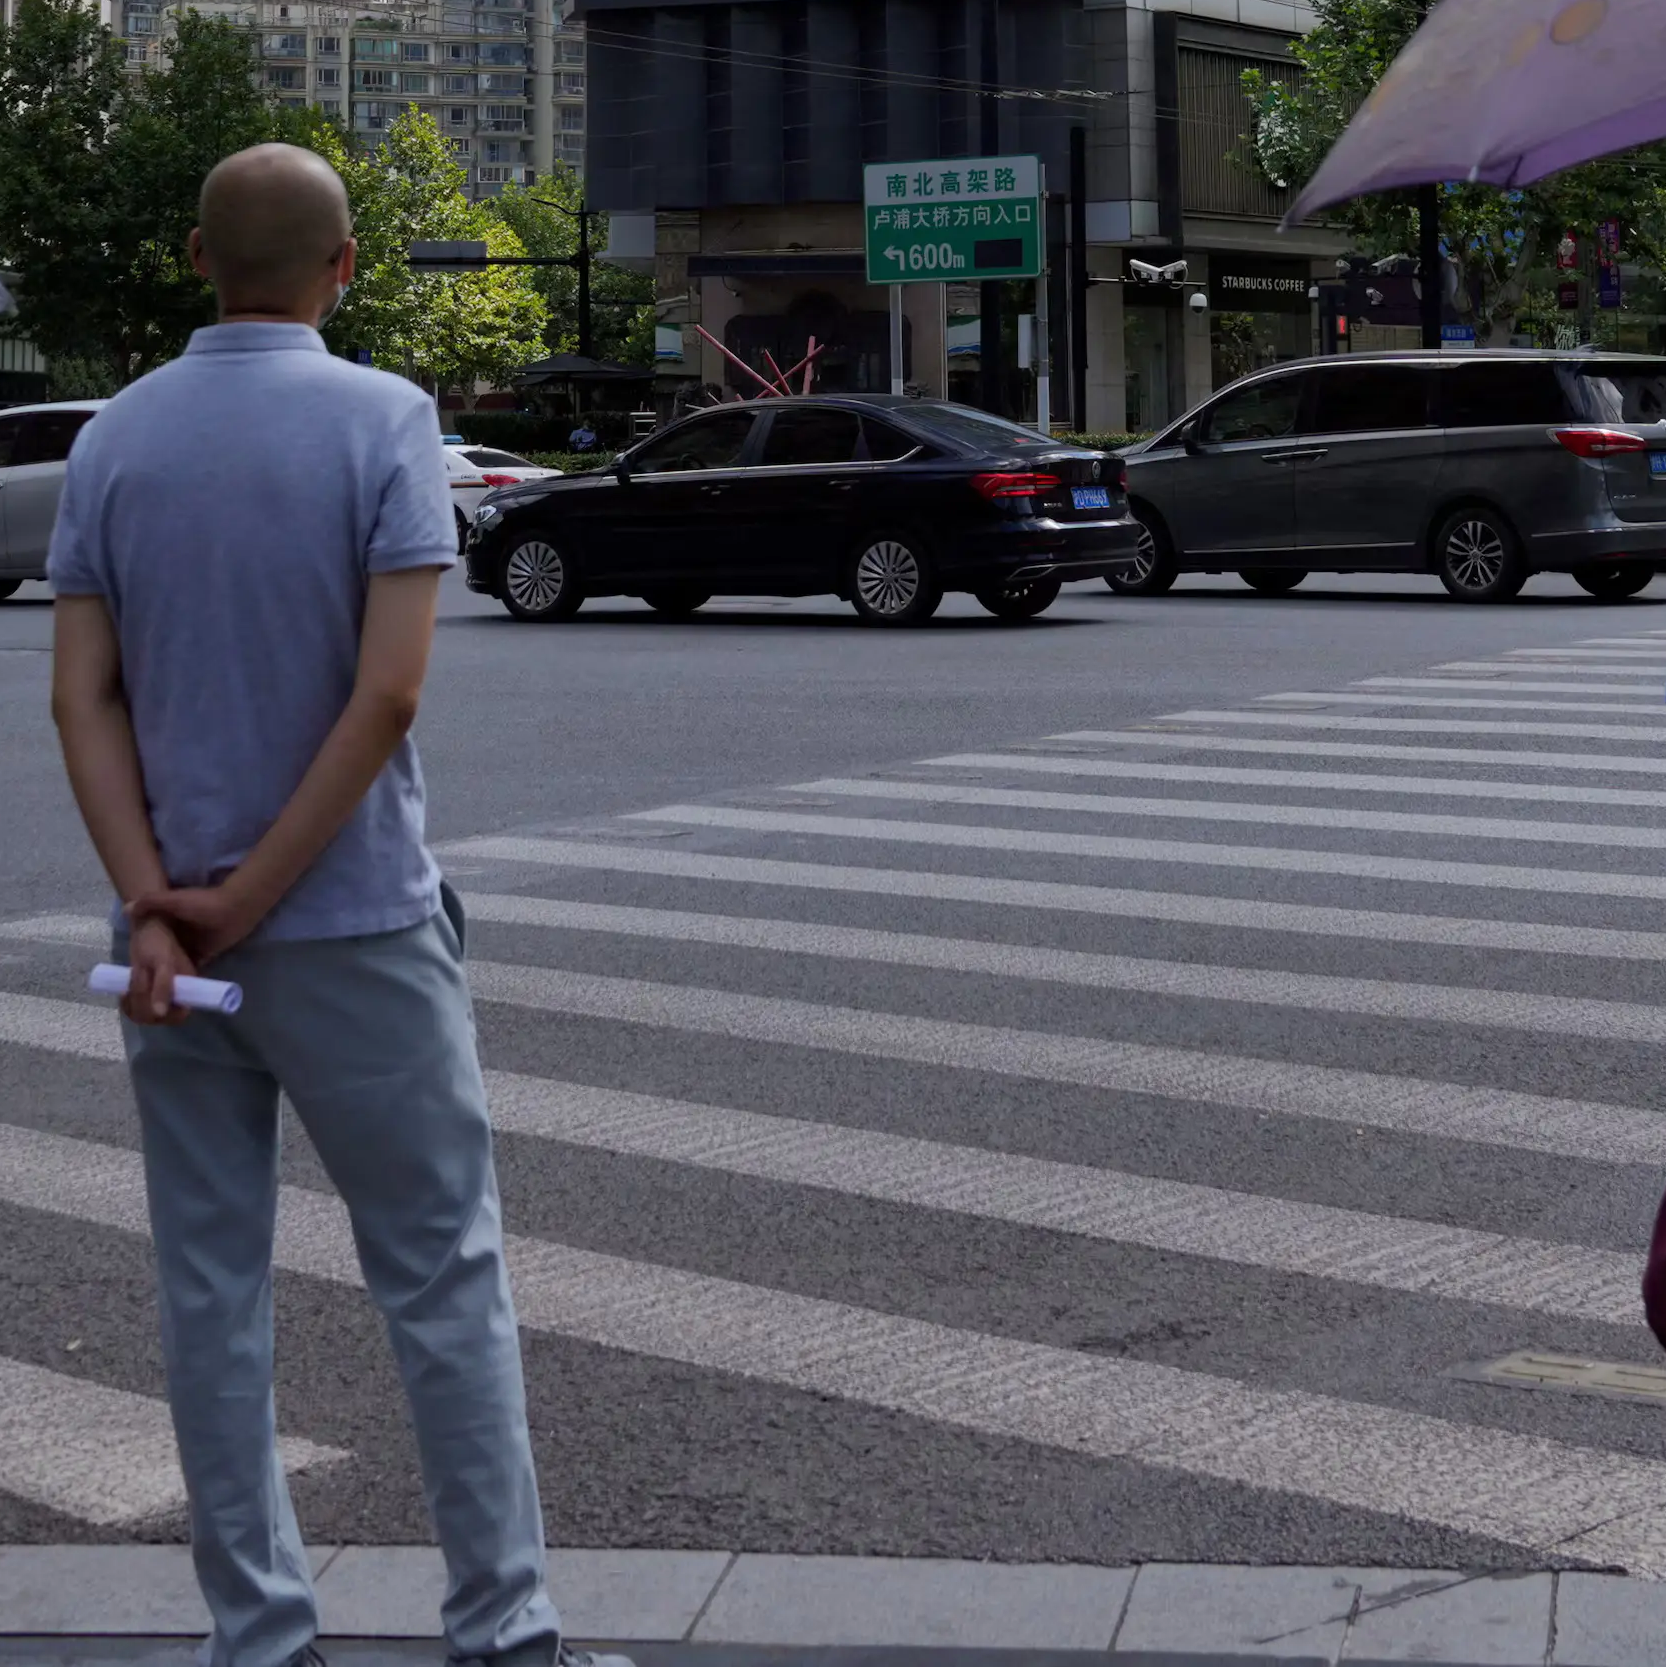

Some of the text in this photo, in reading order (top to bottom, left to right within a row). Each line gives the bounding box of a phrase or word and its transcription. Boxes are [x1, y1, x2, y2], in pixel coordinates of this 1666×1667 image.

[886, 167, 1017, 198] 南北高架路
[873, 204, 1031, 231] 卢浦大桥方向入口
[909, 242, 965, 271] 600m
[1222, 275, 1305, 293] STARBUCKS COFFEE
